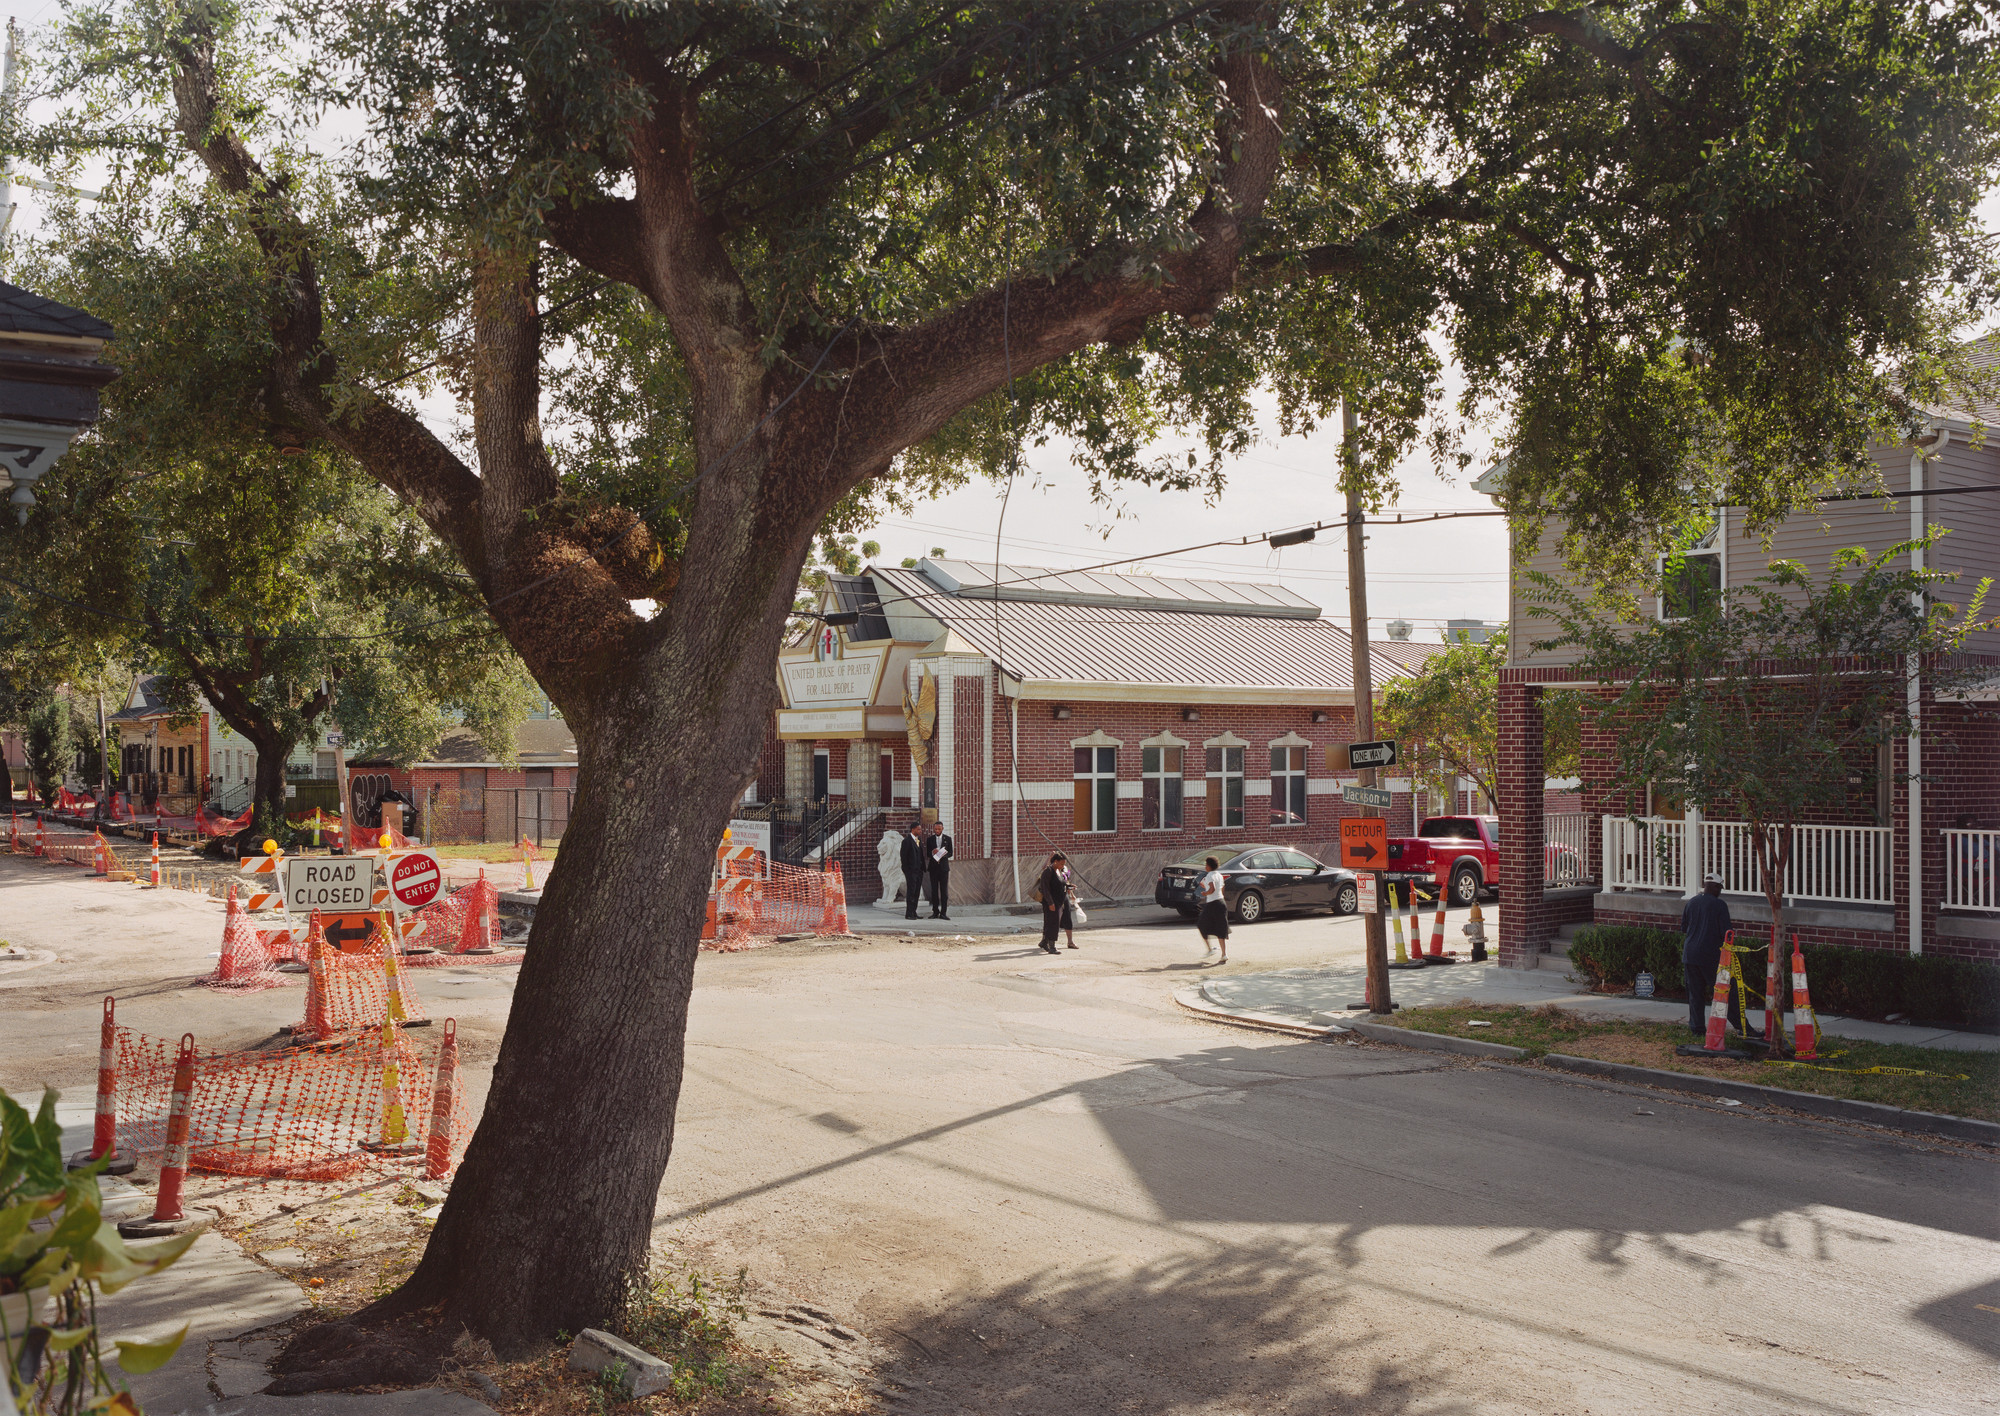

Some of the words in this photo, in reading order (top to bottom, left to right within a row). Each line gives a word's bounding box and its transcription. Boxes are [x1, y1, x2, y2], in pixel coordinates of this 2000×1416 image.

[791, 668, 815, 680] UNITED
[816, 666, 835, 678] HOUSE
[837, 665, 846, 677] OF
[847, 663, 871, 676] PRAYER
[806, 684, 818, 696] FOR
[820, 683, 832, 695] ALL
[833, 682, 855, 694] PEOPLE
[1354, 750, 1368, 762] ONE
[1369, 749, 1383, 760] WAY
[1345, 788, 1380, 804] Jackson
[1344, 825, 1383, 837] DETOUR
[306, 865, 356, 883] ROAD
[398, 866, 411, 878] DO
[413, 859, 431, 873] NOT
[405, 882, 436, 900] ENTER
[1358, 880, 1366, 888] NO
[294, 888, 364, 905] CLOSED
[1879, 1067, 1917, 1076] CAUTION
